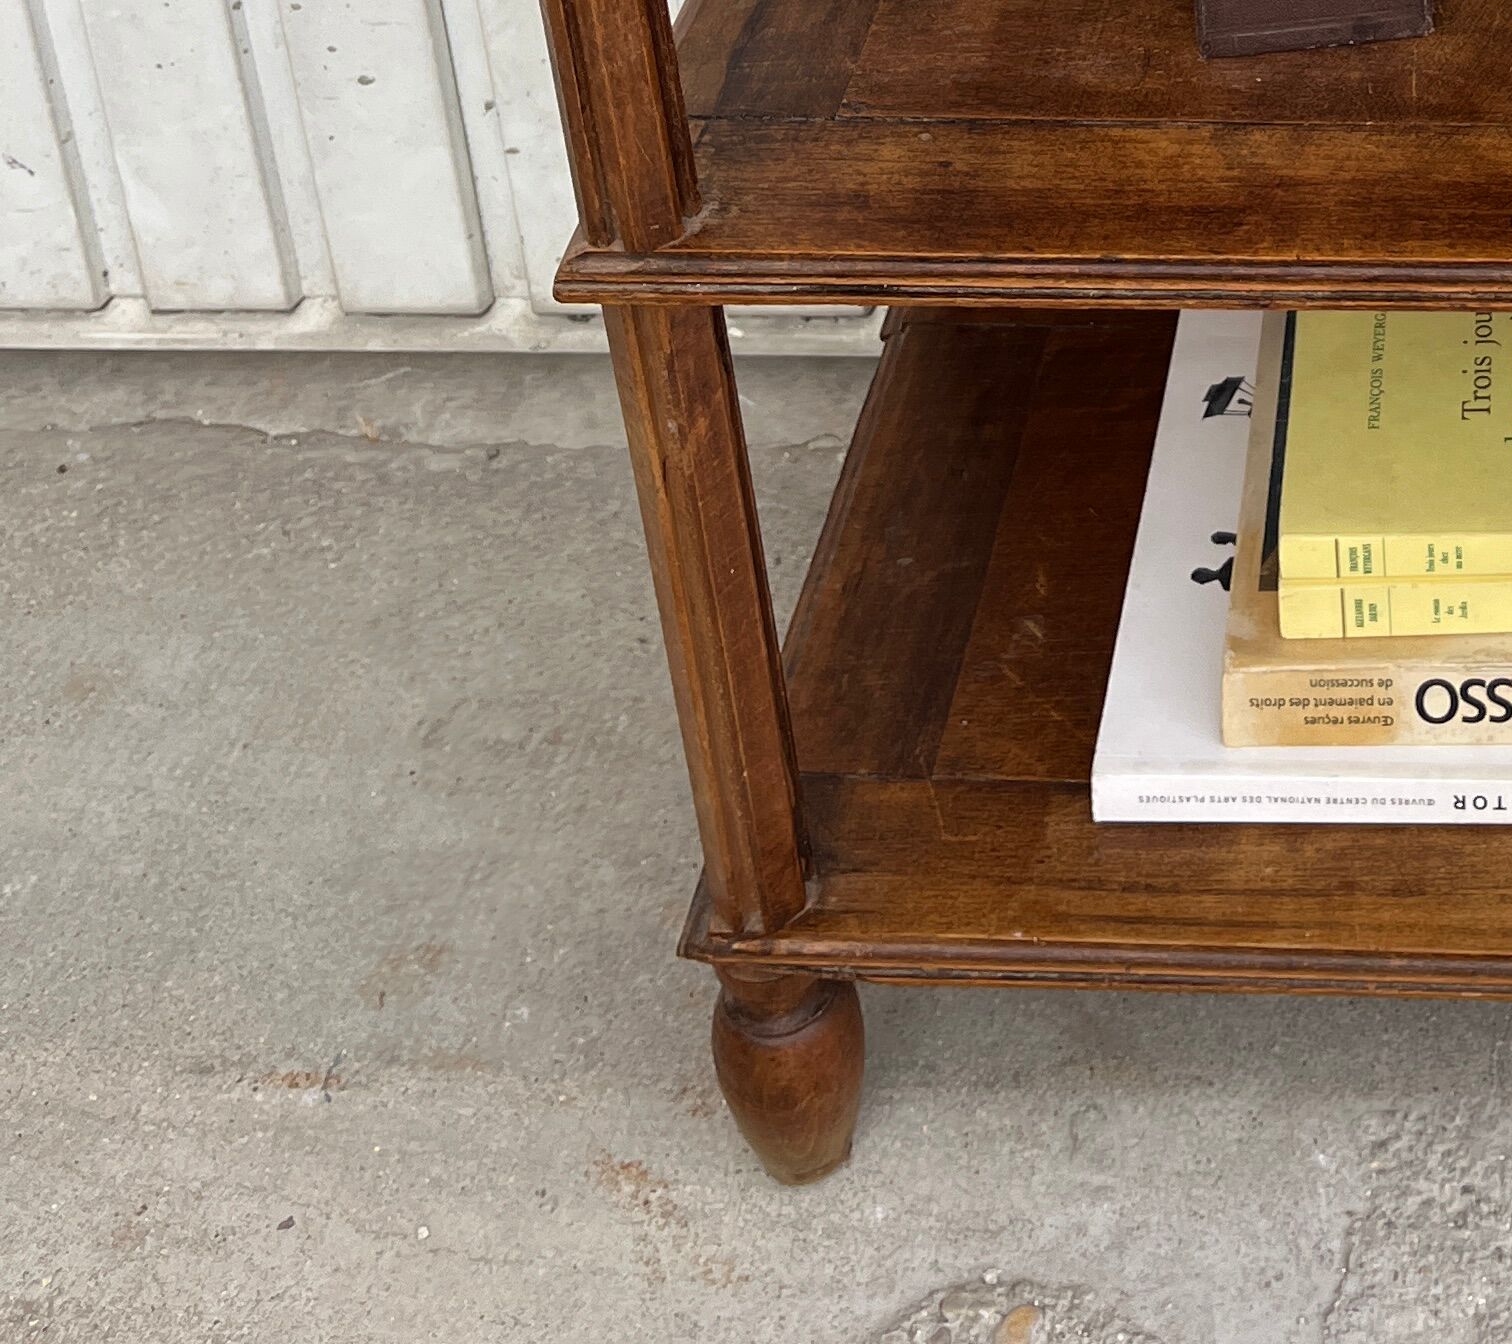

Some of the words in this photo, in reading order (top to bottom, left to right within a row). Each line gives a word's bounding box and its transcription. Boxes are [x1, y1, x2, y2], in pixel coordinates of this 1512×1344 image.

[1371, 311, 1387, 363] WEYERG
[1461, 355, 1492, 421] Trois
[1367, 367, 1385, 430] FRANÇOIS
[1309, 678, 1375, 691] succession
[1377, 678, 1394, 690] de
[1248, 697, 1286, 710] droits
[1289, 697, 1311, 710] des
[1312, 694, 1374, 709] paiement
[1378, 696, 1394, 707] en
[1303, 713, 1345, 726] reçues
[1346, 715, 1395, 727] Œuvres
[1136, 794, 1207, 804] PLASTIQUES
[1208, 794, 1238, 805] ARTS
[1240, 795, 1263, 805] DES
[1265, 795, 1322, 805] NATIONAL
[1324, 796, 1369, 806] CENTRE
[1370, 796, 1387, 806] DU
[1389, 796, 1436, 806] ŒUVRES
